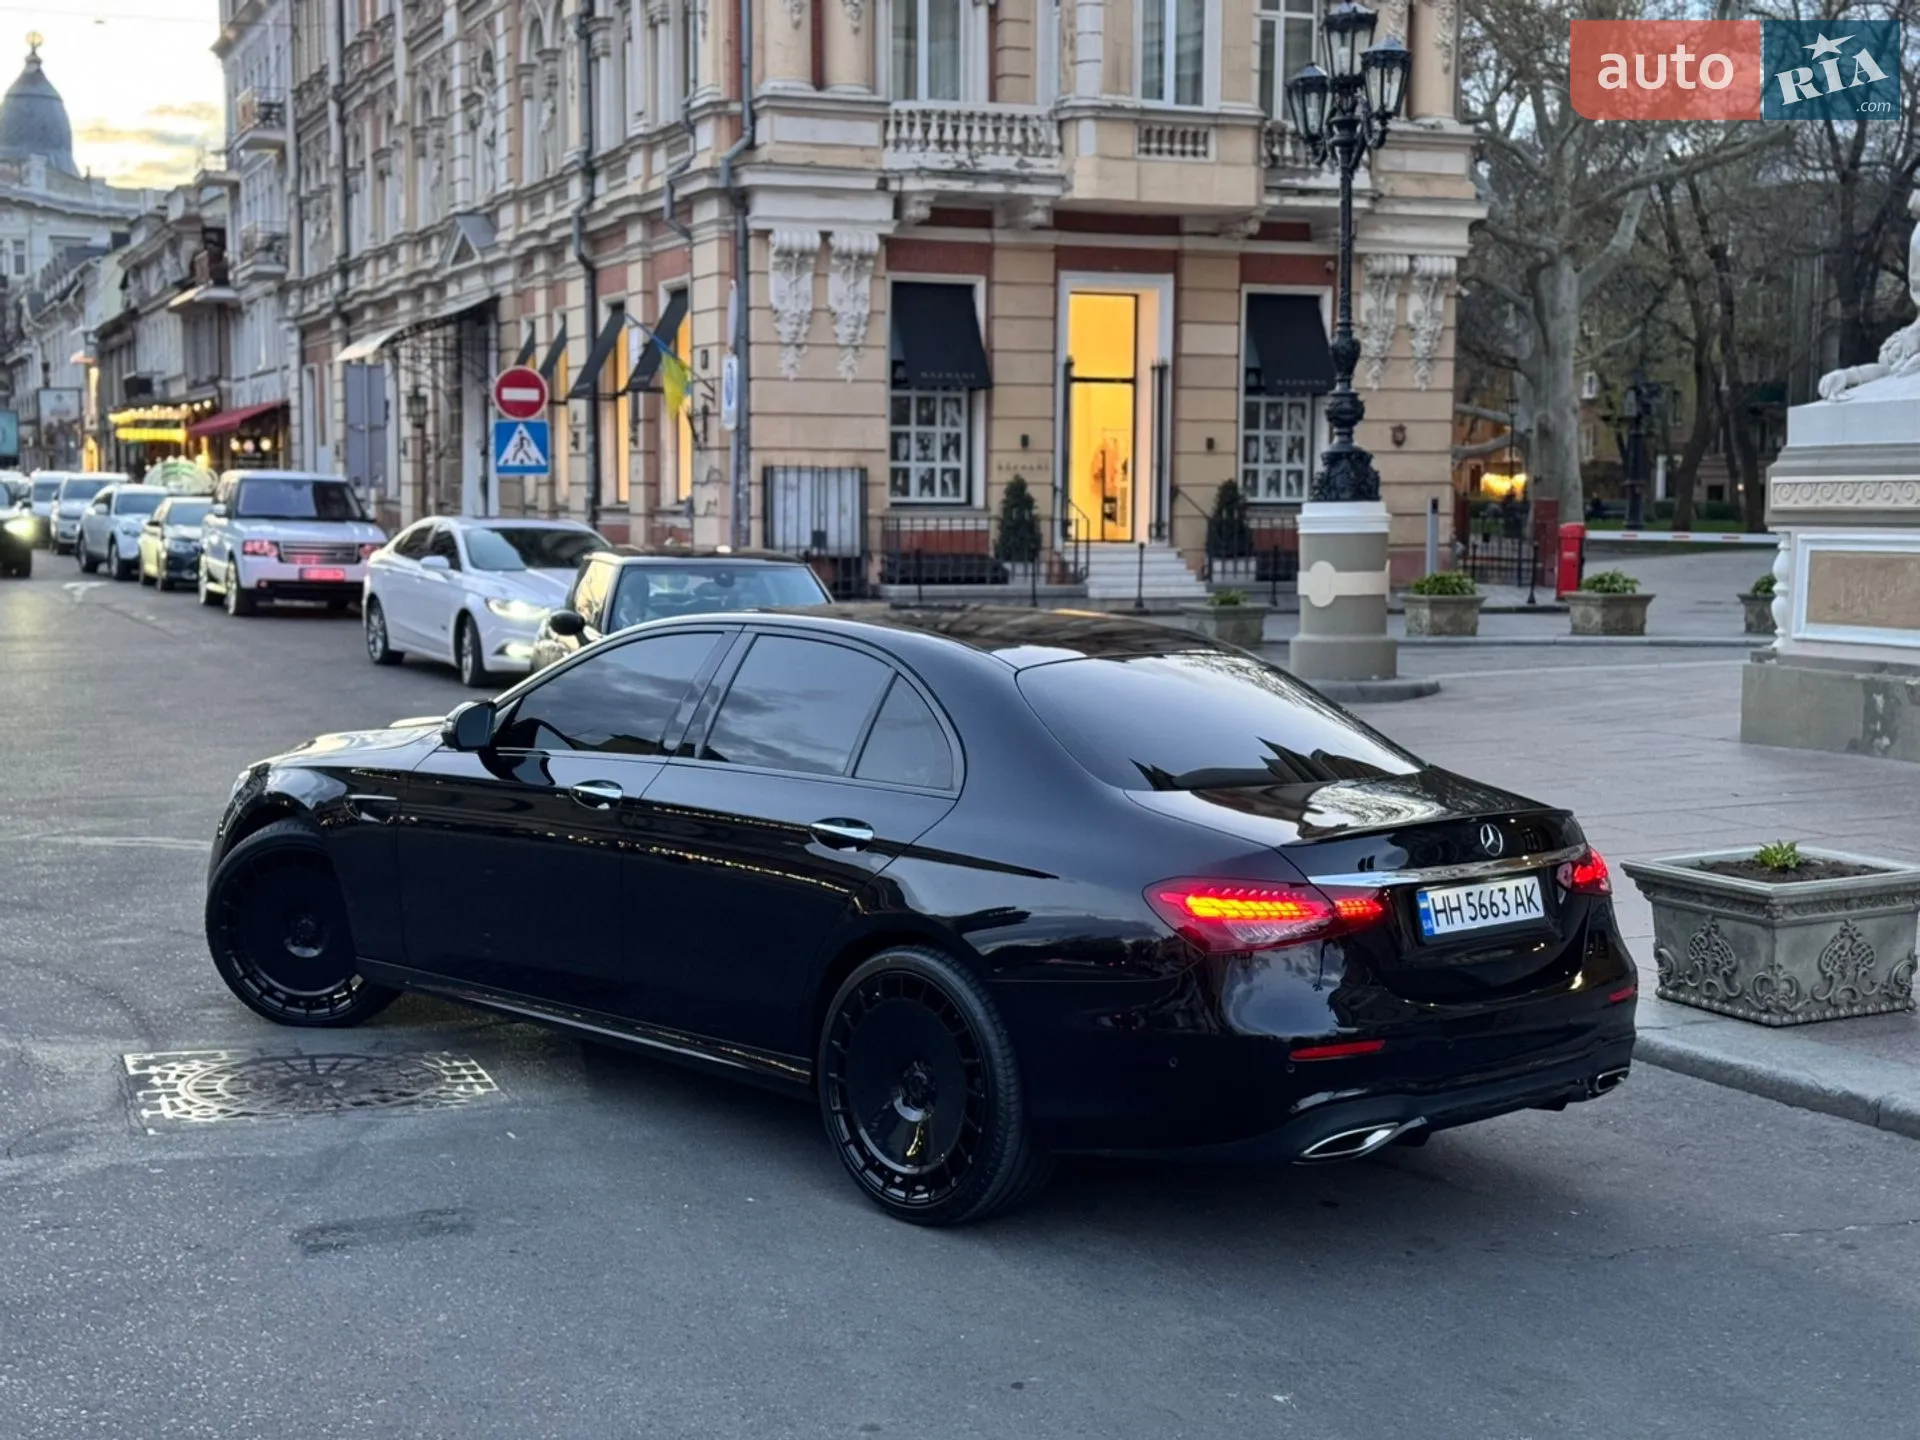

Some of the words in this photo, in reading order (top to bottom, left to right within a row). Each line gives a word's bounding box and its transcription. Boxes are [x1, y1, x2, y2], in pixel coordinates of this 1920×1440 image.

[1431, 893, 1464, 927] HH
[1465, 887, 1511, 922] 5663
[1514, 882, 1540, 915] AK
